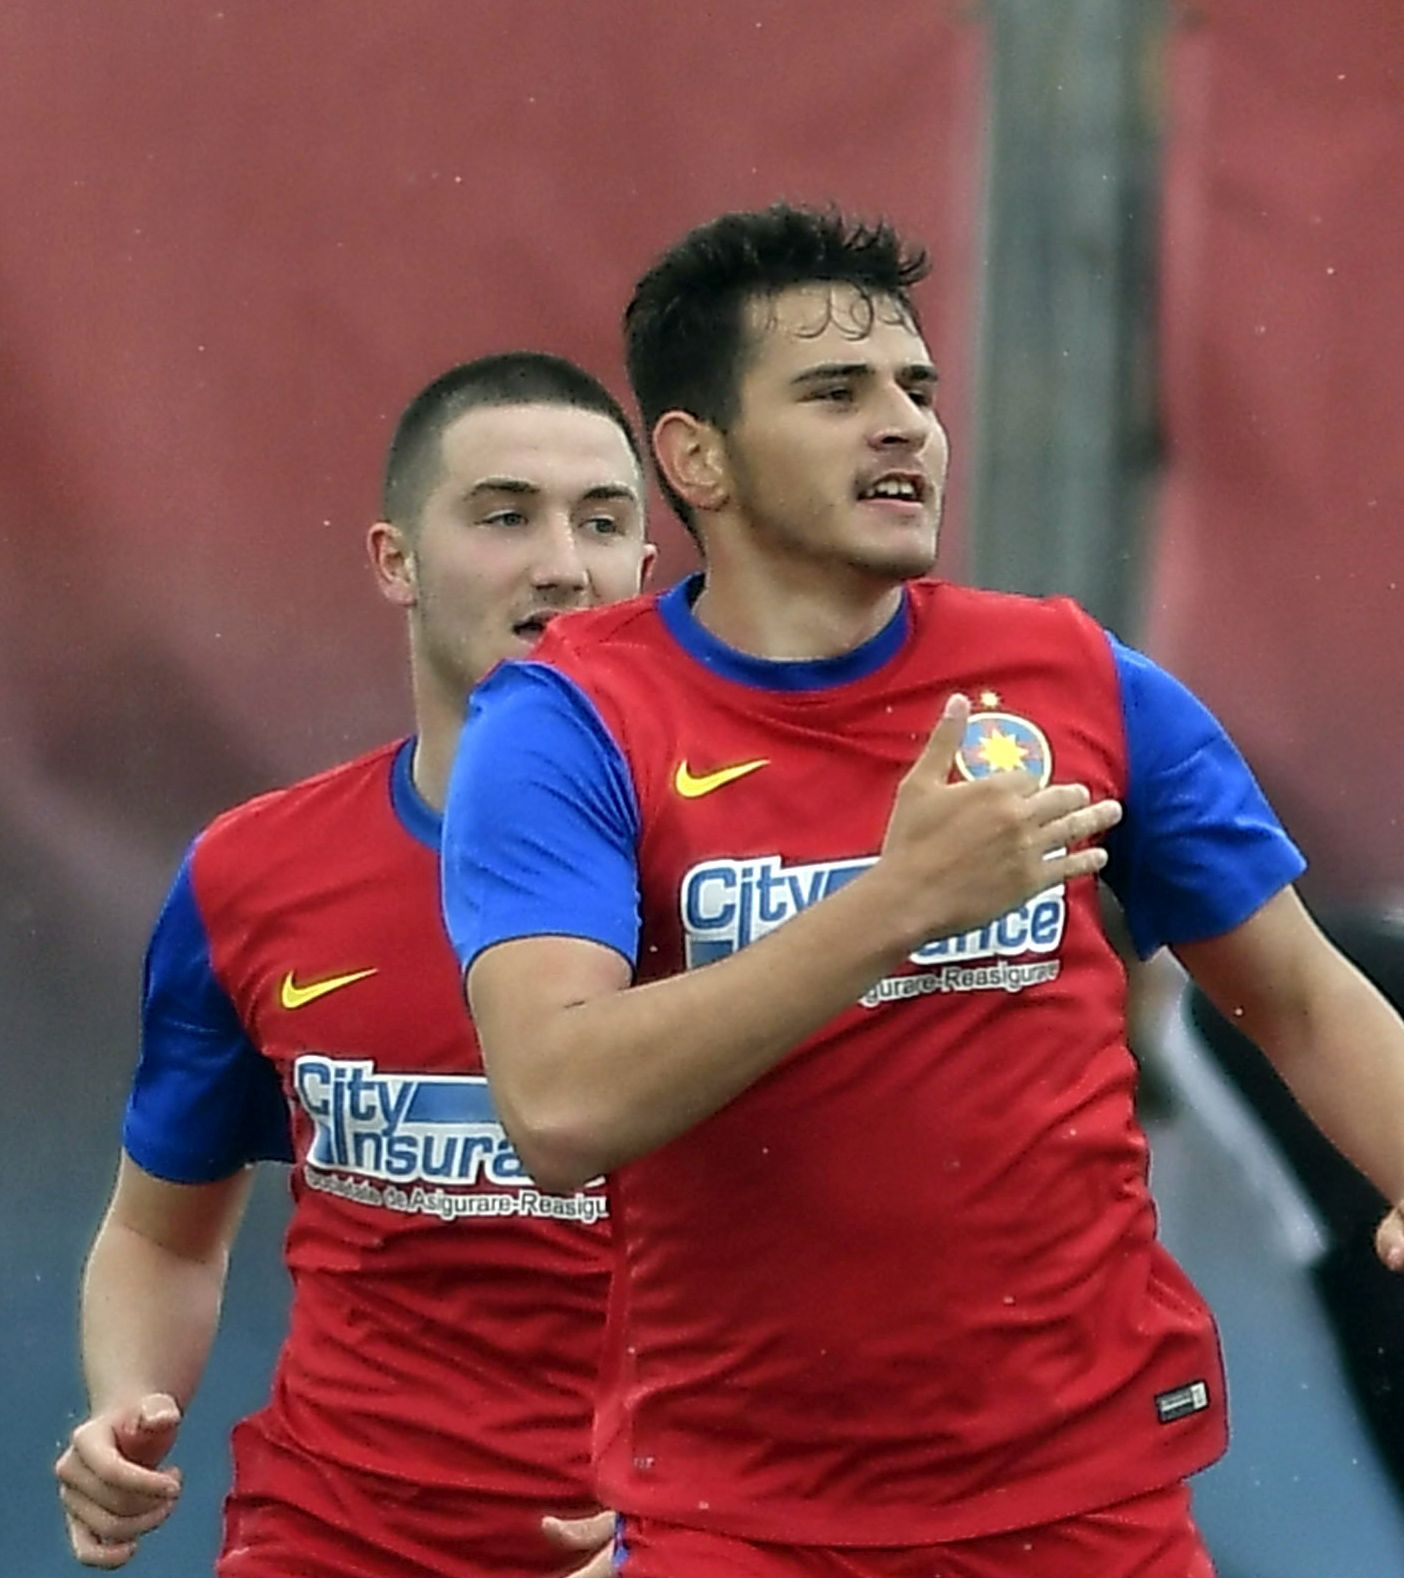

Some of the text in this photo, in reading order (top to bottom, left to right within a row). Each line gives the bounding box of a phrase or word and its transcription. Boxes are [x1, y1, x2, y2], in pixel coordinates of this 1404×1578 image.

[299, 1061, 414, 1136] City
[334, 1130, 530, 1179] Insura
[410, 1188, 608, 1221] Asigurare-Reasigu
